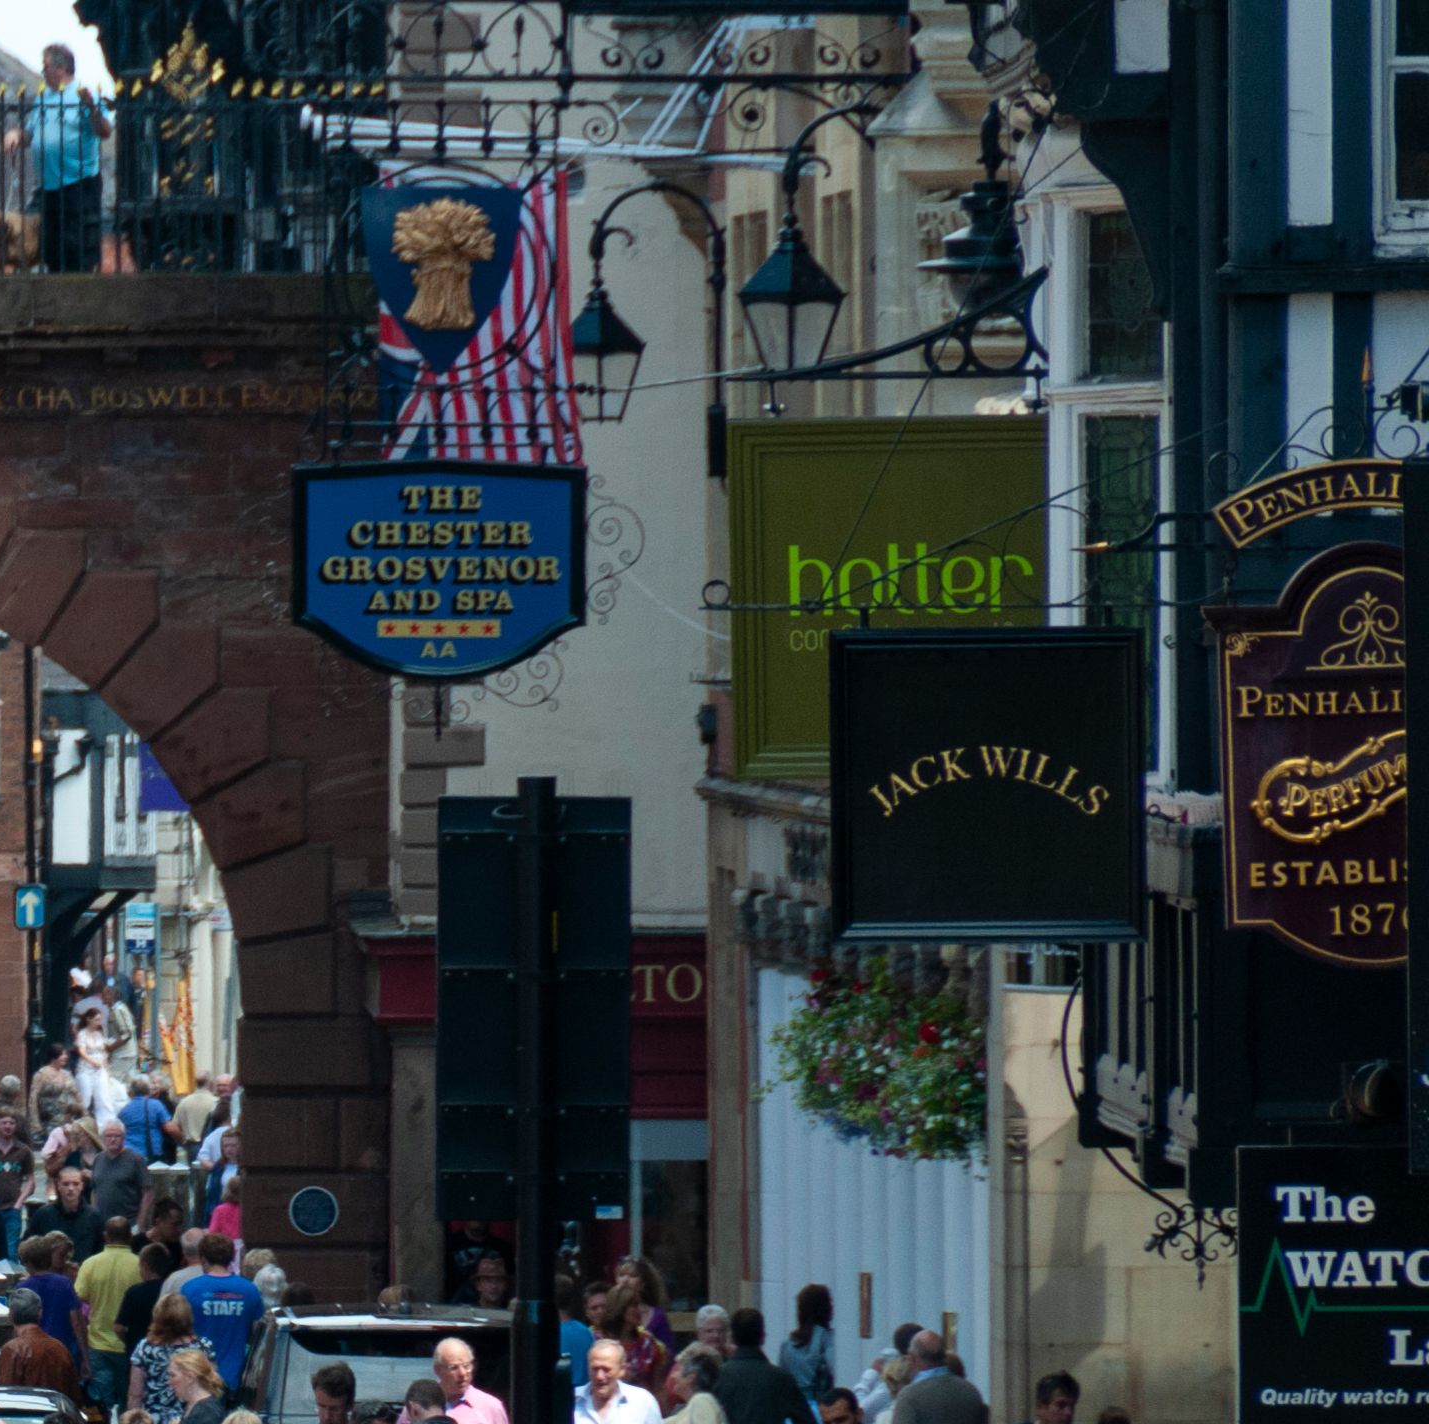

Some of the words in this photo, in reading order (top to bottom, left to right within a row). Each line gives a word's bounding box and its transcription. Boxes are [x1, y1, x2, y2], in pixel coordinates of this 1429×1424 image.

[90, 385, 233, 409] BOSWELL
[402, 485, 483, 512] THE
[349, 520, 534, 547] CHESTER
[321, 555, 563, 583] GROSVENOR
[788, 543, 1034, 616] hotter
[367, 589, 441, 613] AND
[455, 589, 515, 613] SPA
[420, 641, 458, 659] AA
[869, 747, 972, 817] JACK
[979, 745, 1110, 816] WILLS
[1275, 1185, 1376, 1224] The
[201, 1300, 245, 1316] STAFF
[1388, 1329, 1429, 1366] L
[1260, 1388, 1338, 1408] Quality
[1343, 1388, 1409, 1405] watch
